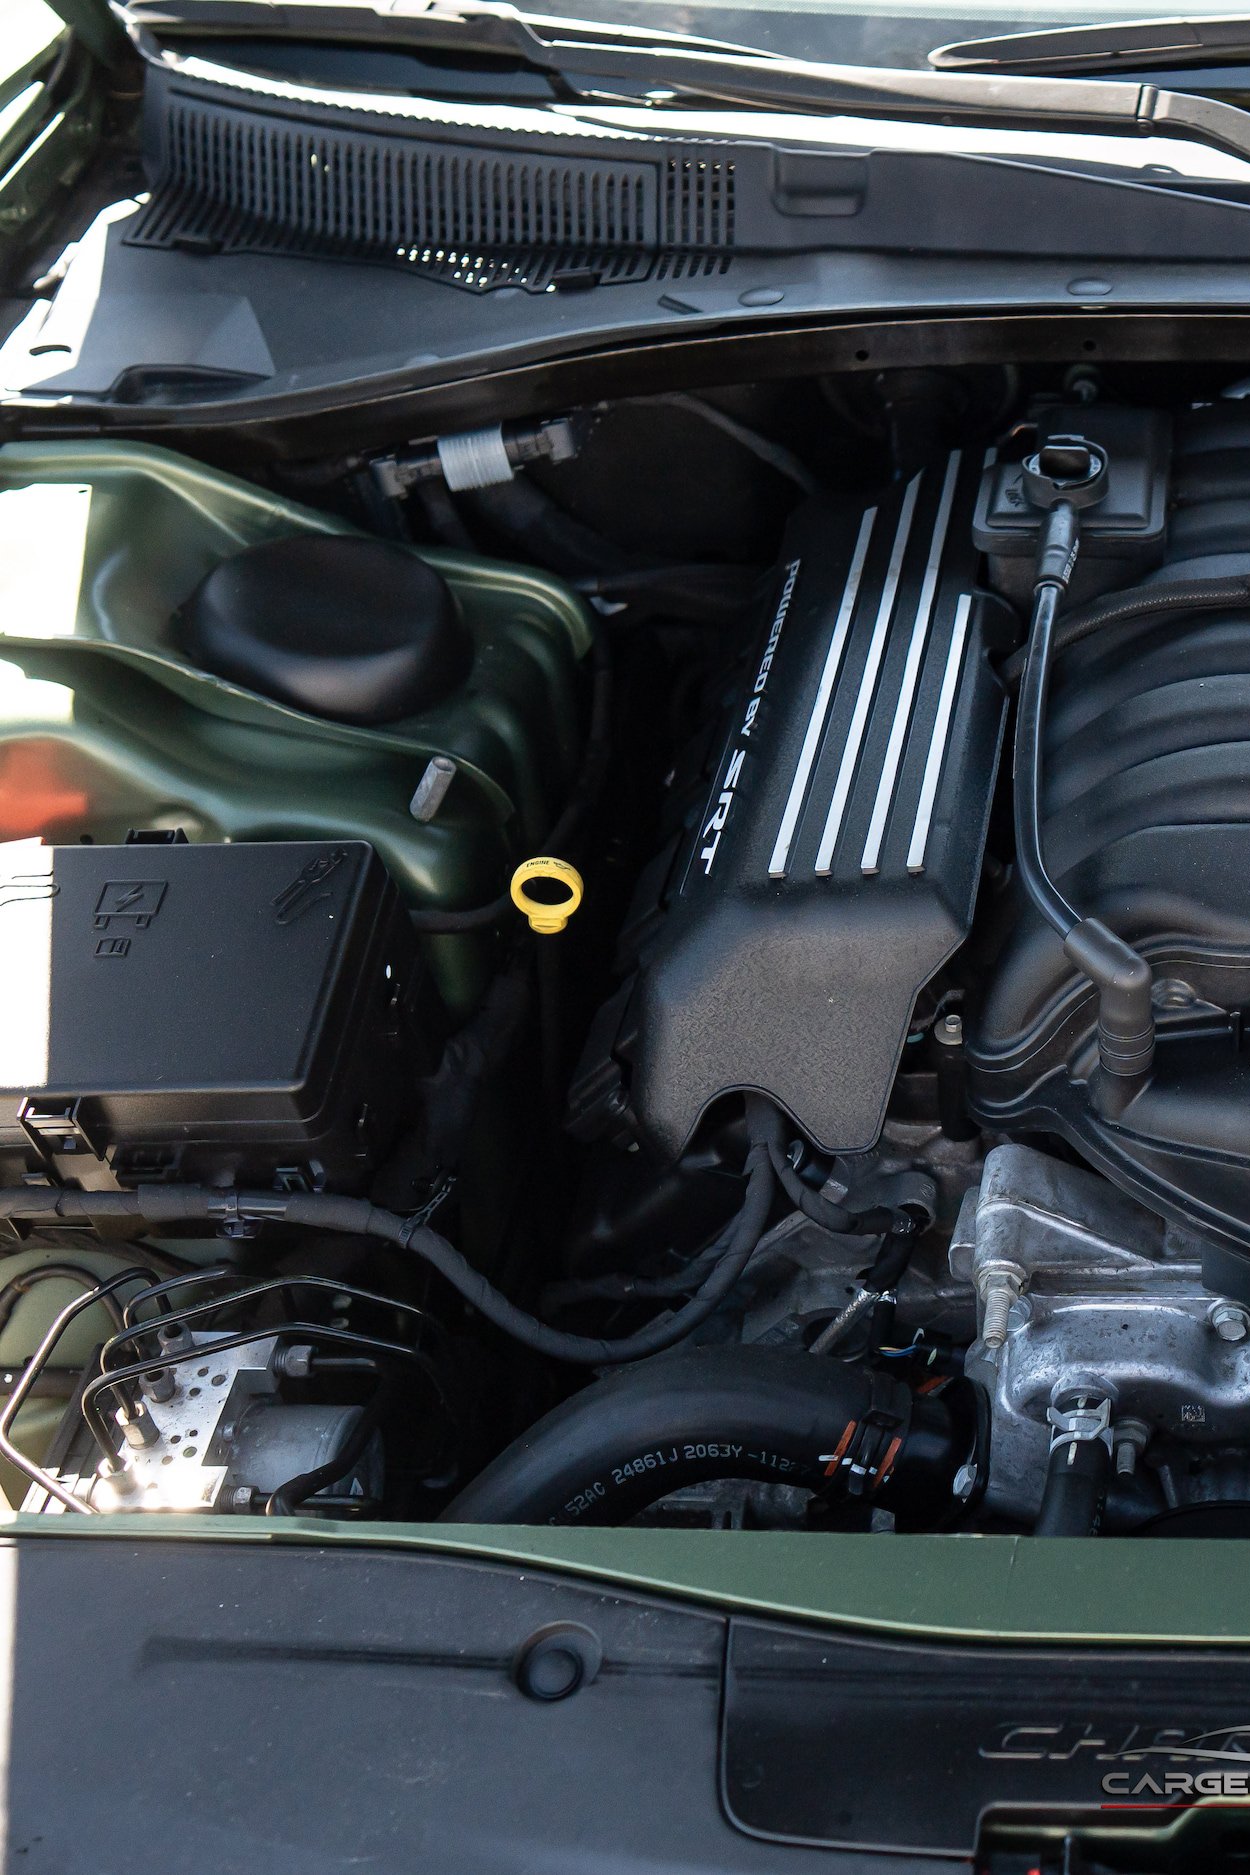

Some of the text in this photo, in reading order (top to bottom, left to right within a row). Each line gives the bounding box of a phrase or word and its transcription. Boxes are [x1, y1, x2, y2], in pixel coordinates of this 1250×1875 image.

[700, 559, 801, 876] POWERED BY SRT
[526, 860, 550, 868] ENGINE
[564, 1481, 606, 1517] 52AC
[611, 1447, 679, 1485] 24861J
[683, 1443, 743, 1461] 2063Y
